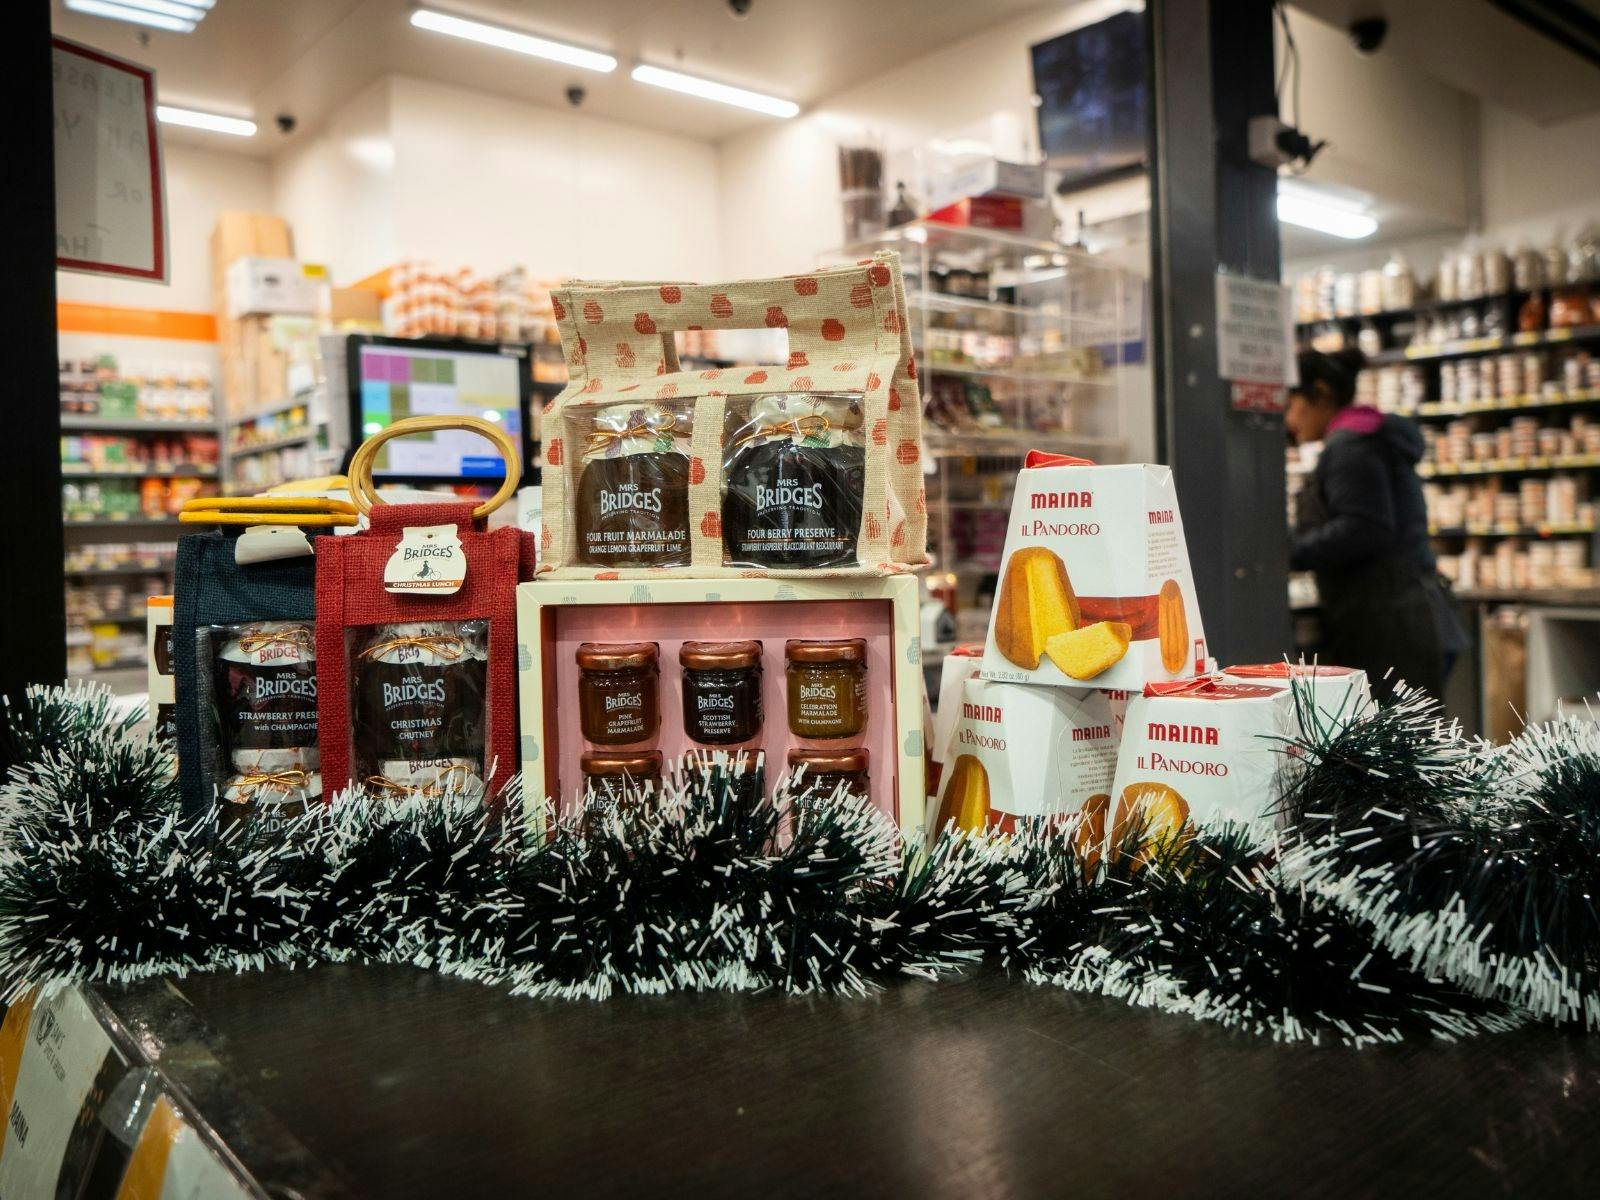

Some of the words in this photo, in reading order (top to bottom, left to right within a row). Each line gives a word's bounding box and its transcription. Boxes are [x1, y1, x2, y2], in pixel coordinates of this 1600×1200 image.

[619, 484, 638, 492] MRS
[600, 488, 662, 515] BRIDGES
[756, 483, 822, 511] BRIDGES
[1031, 491, 1092, 509] MAINA
[1149, 510, 1174, 524] MAINA
[748, 530, 766, 539] FOUR
[768, 529, 792, 538] BERRY
[794, 528, 835, 538] PRESERVE
[1022, 525, 1030, 536] IL
[1033, 520, 1100, 536] PANDORO
[586, 532, 602, 542] FOUR
[604, 532, 624, 542] FRUIT
[627, 530, 686, 540] MARMALADE
[404, 546, 453, 560] BRIDGES
[608, 544, 627, 553] LEMON
[628, 544, 664, 552] GRAPEFRUIT
[666, 544, 682, 552] LIME
[256, 676, 316, 698] BRIDGES
[402, 676, 422, 684] MRS
[384, 679, 445, 707] BRIDGES
[800, 684, 836, 699] BRIDGES
[606, 693, 642, 710] BRIDGES
[698, 695, 734, 709] BRIDGES
[239, 712, 293, 720] STRAWBERRY
[964, 703, 1002, 723] MAINA
[391, 718, 442, 729] CHRISTMAS
[608, 718, 642, 727] GRAPEFRUIT
[608, 724, 644, 734] MARMALADE
[400, 730, 434, 740] CHUTNEY
[1072, 725, 1110, 741] MAINA
[1148, 722, 1218, 746] MAINA
[1137, 756, 1148, 770] IL
[1151, 752, 1228, 776] PANDORO
